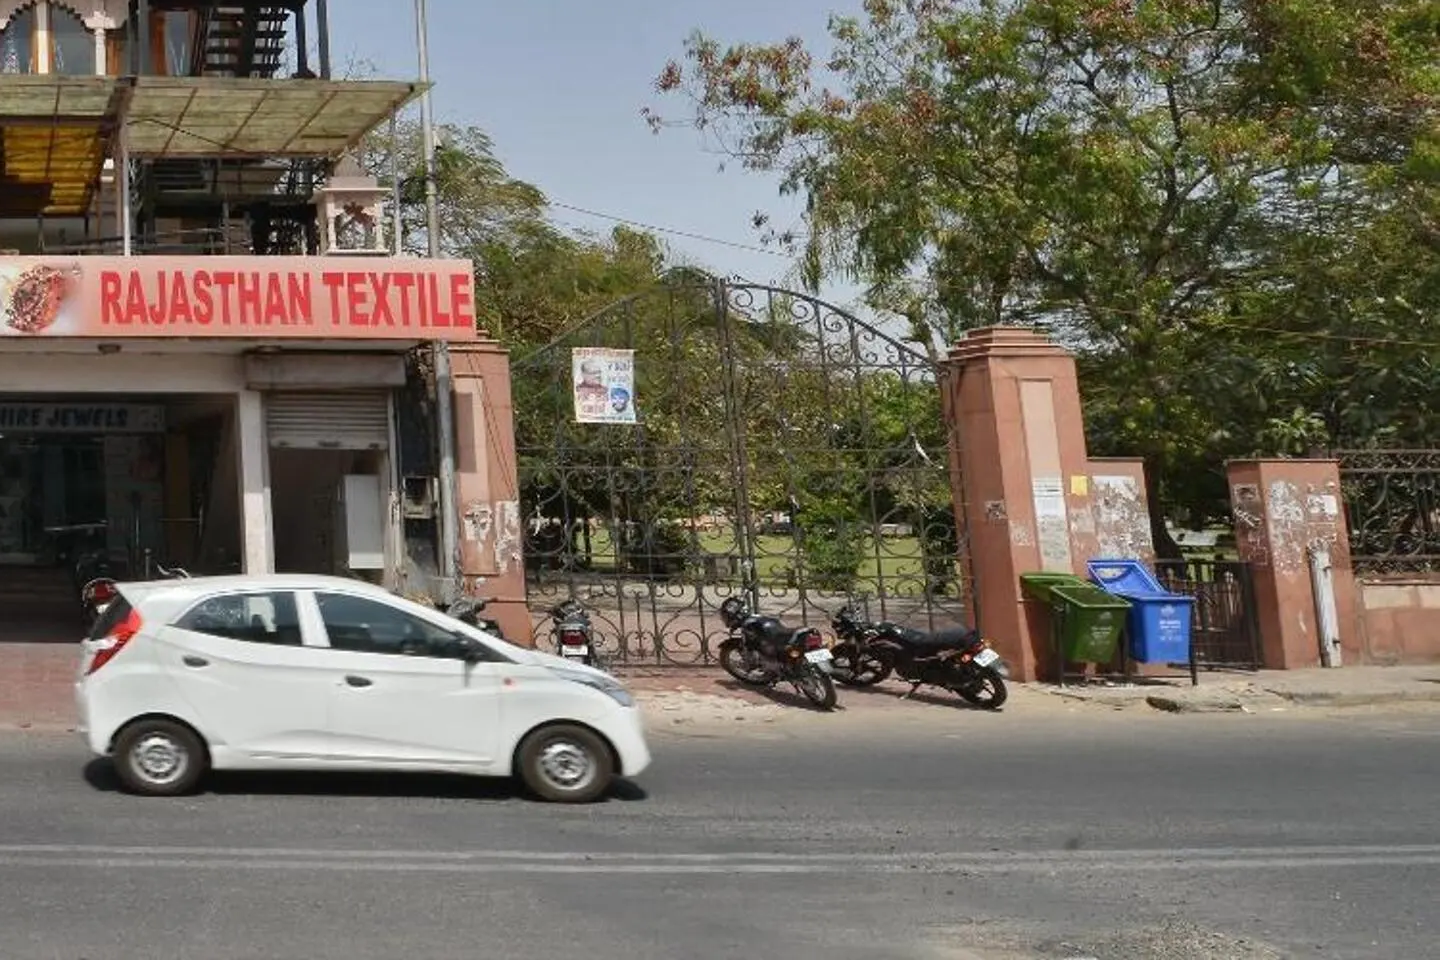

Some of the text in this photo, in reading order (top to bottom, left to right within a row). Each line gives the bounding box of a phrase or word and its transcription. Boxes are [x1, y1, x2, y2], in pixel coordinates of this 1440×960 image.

[100, 270, 473, 328] RAJASTHAN TEXTILE
[46, 406, 128, 428] JEWELS
